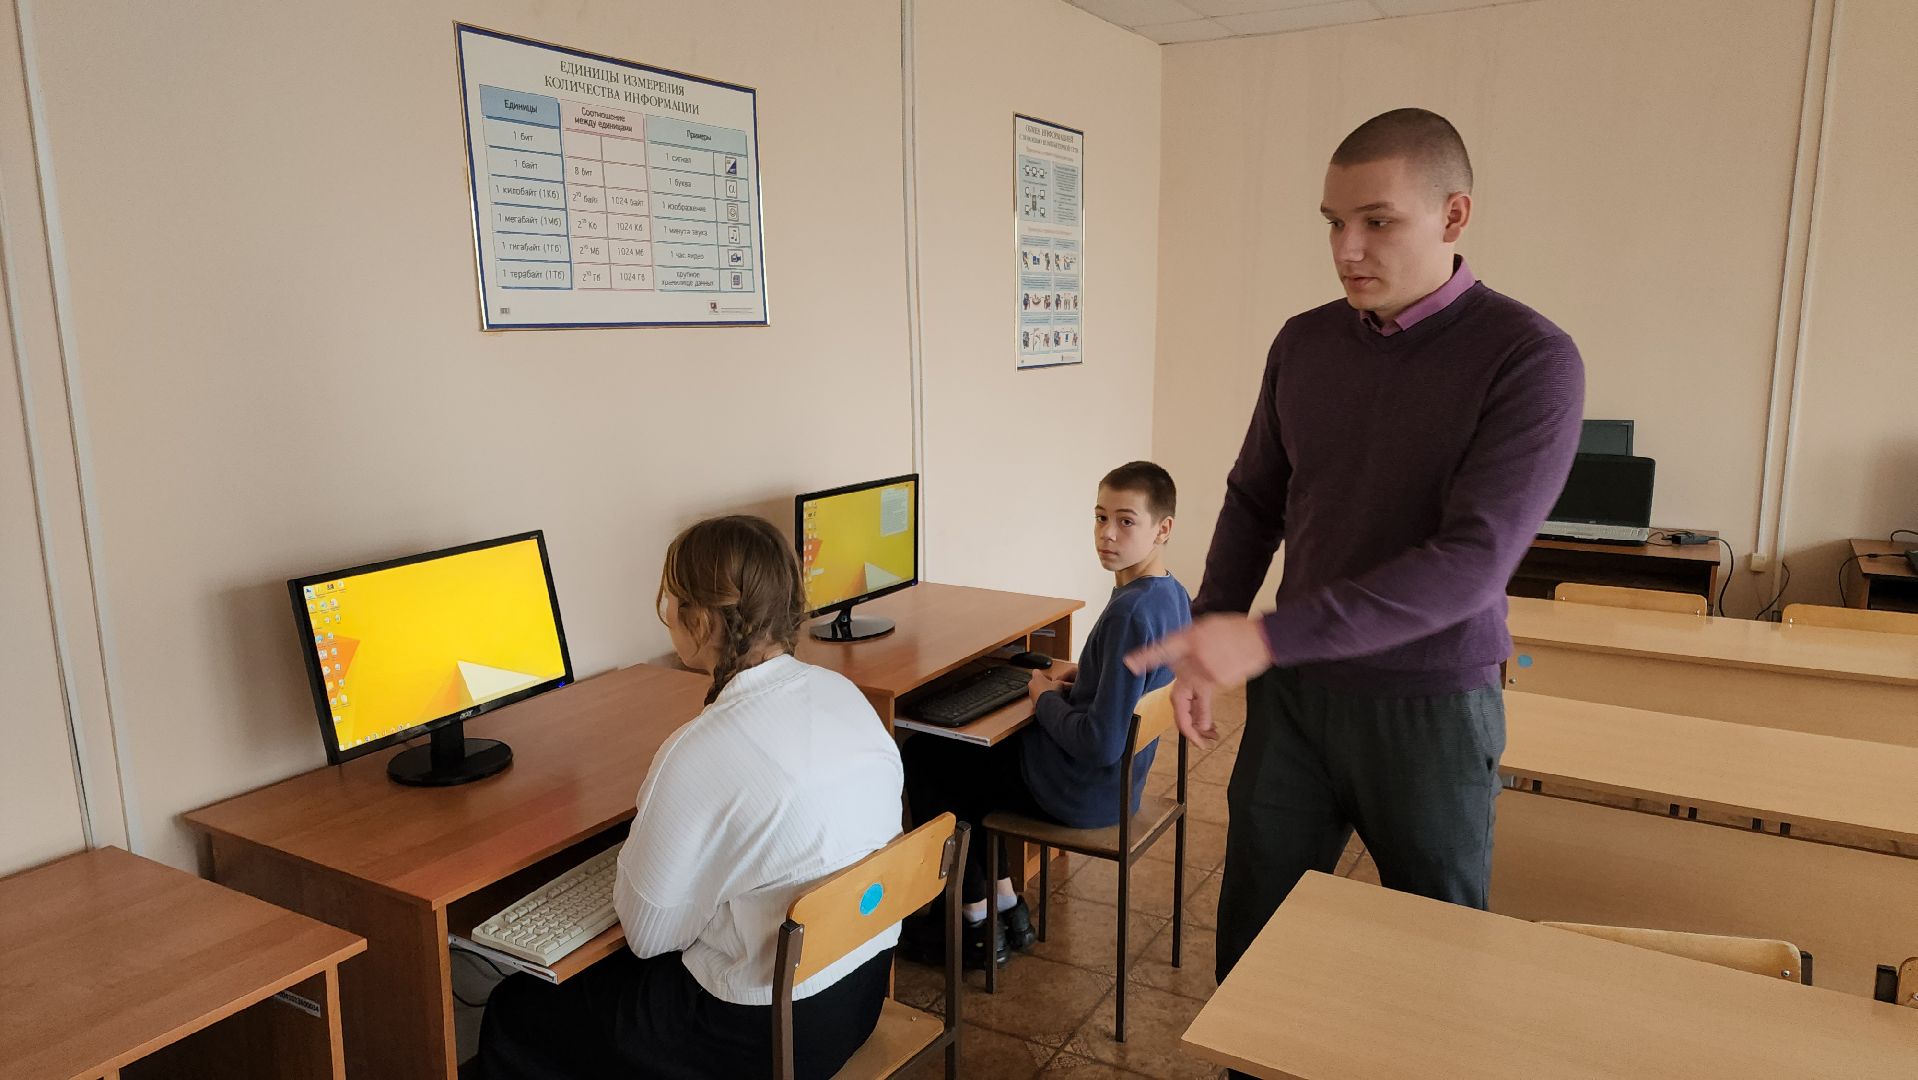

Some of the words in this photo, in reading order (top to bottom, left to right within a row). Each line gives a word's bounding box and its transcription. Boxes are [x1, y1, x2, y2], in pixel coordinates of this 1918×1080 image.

[560, 60, 619, 84] ЕДИНИЦЫ
[623, 73, 685, 96] ИЗМЕРЕНИЯ
[544, 75, 620, 100] КОЛИЧЕСТВА
[624, 91, 700, 115] ИНФОРМАЦИИ
[504, 99, 538, 114] Единицы
[581, 107, 625, 122] Соотношение
[575, 117, 596, 128] между
[598, 121, 632, 132] единицами
[513, 131, 517, 140] 1
[520, 132, 534, 141] бит
[514, 159, 518, 167] 1
[521, 160, 538, 169] байт
[575, 166, 579, 175] 8
[582, 167, 592, 176] бит
[496, 184, 500, 193] 1
[502, 187, 537, 197] килобайт
[539, 188, 560, 200] (1Кб)
[611, 196, 628, 205] 1024
[498, 212, 502, 222] 1
[504, 215, 538, 224] мегабайт
[616, 222, 632, 231] 1024
[502, 241, 506, 250] 1
[509, 242, 540, 252] гигабайт
[510, 270, 542, 279] терабайт
[620, 272, 636, 281] 1024
